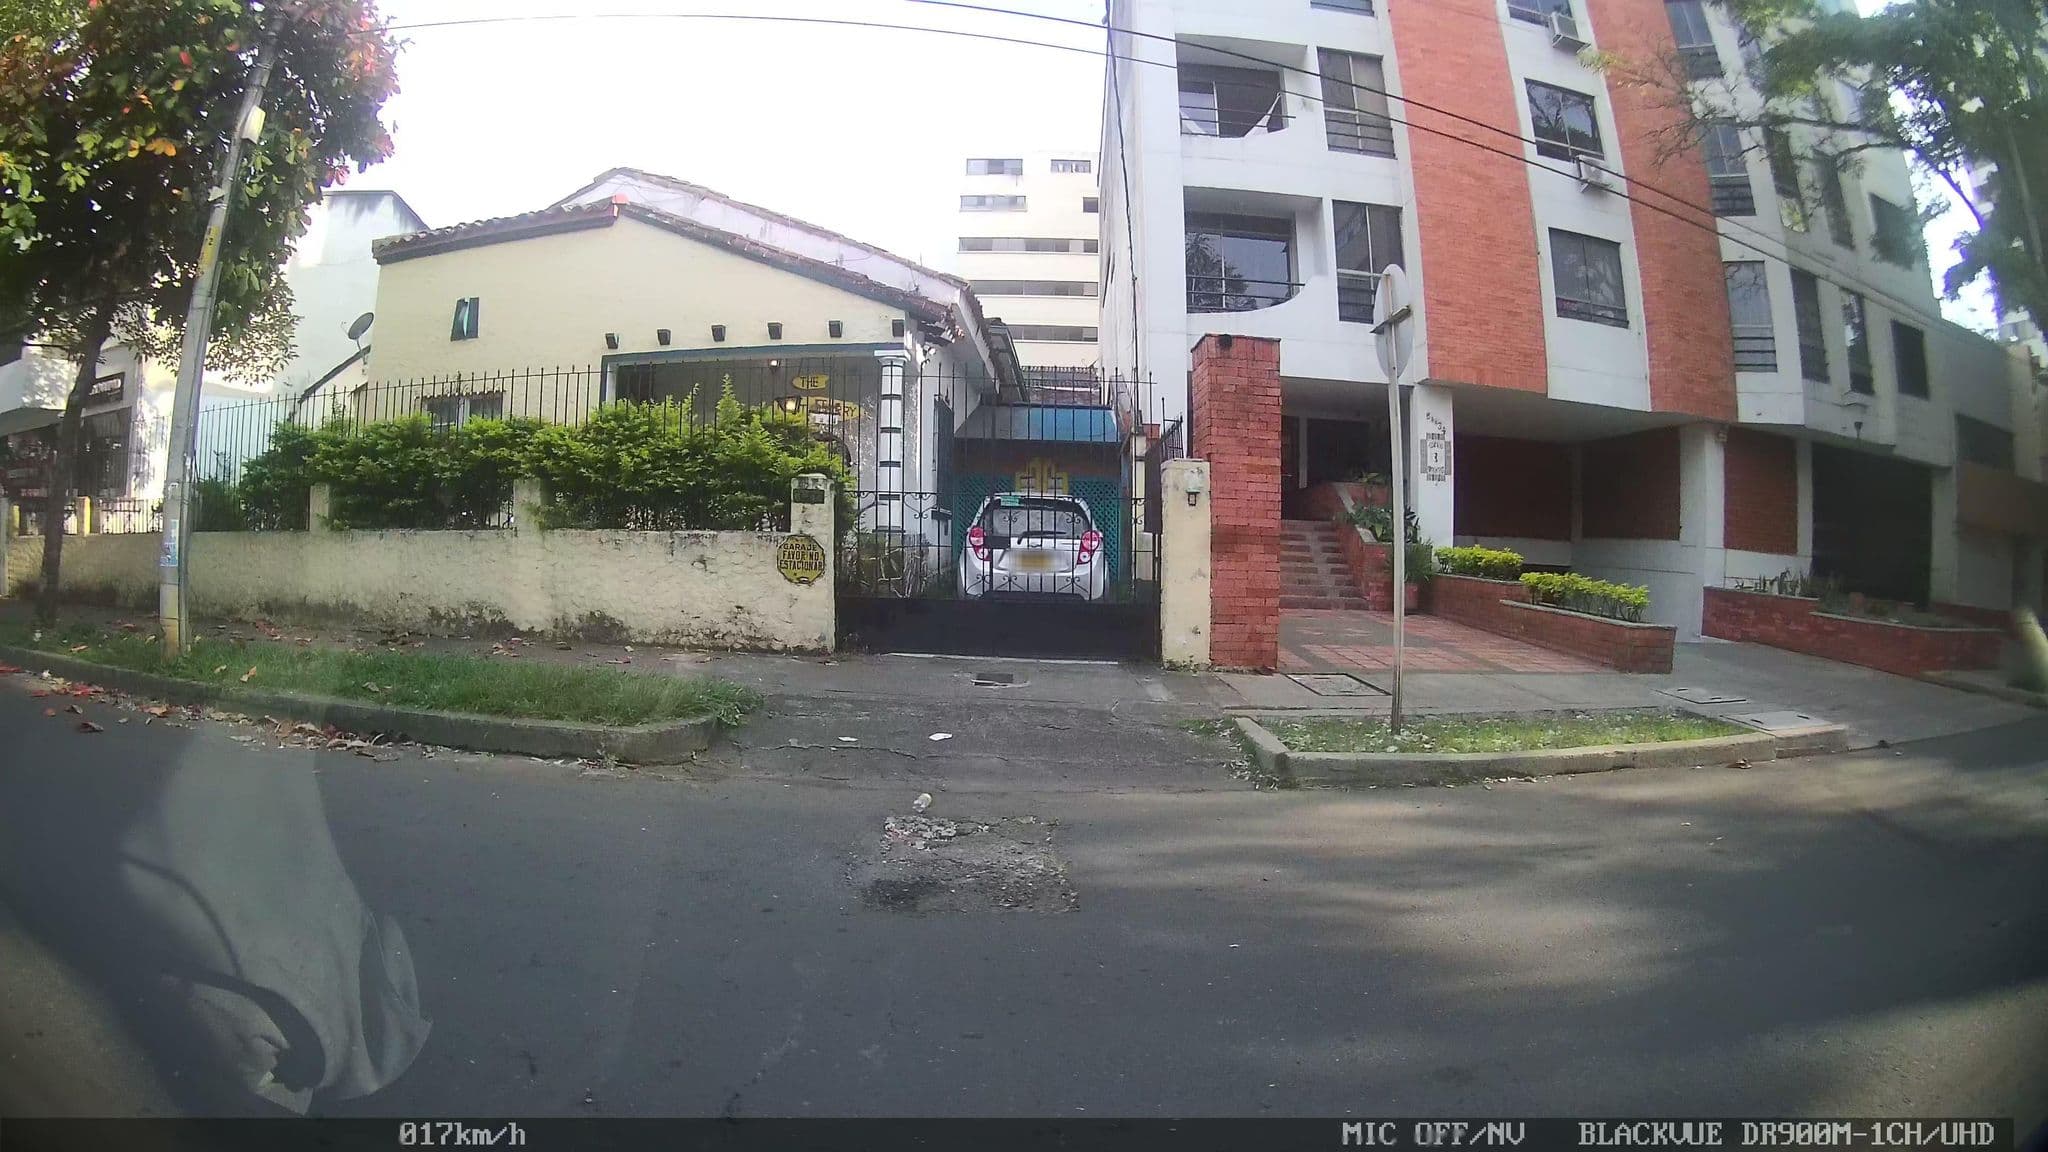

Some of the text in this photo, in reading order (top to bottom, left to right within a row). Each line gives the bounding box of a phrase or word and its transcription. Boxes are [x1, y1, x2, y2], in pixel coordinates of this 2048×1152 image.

[800, 376, 819, 388] THE
[783, 543, 818, 551] GARAJE
[782, 551, 820, 561] FAVOR NO
[780, 560, 824, 571] ESTACIONAR
